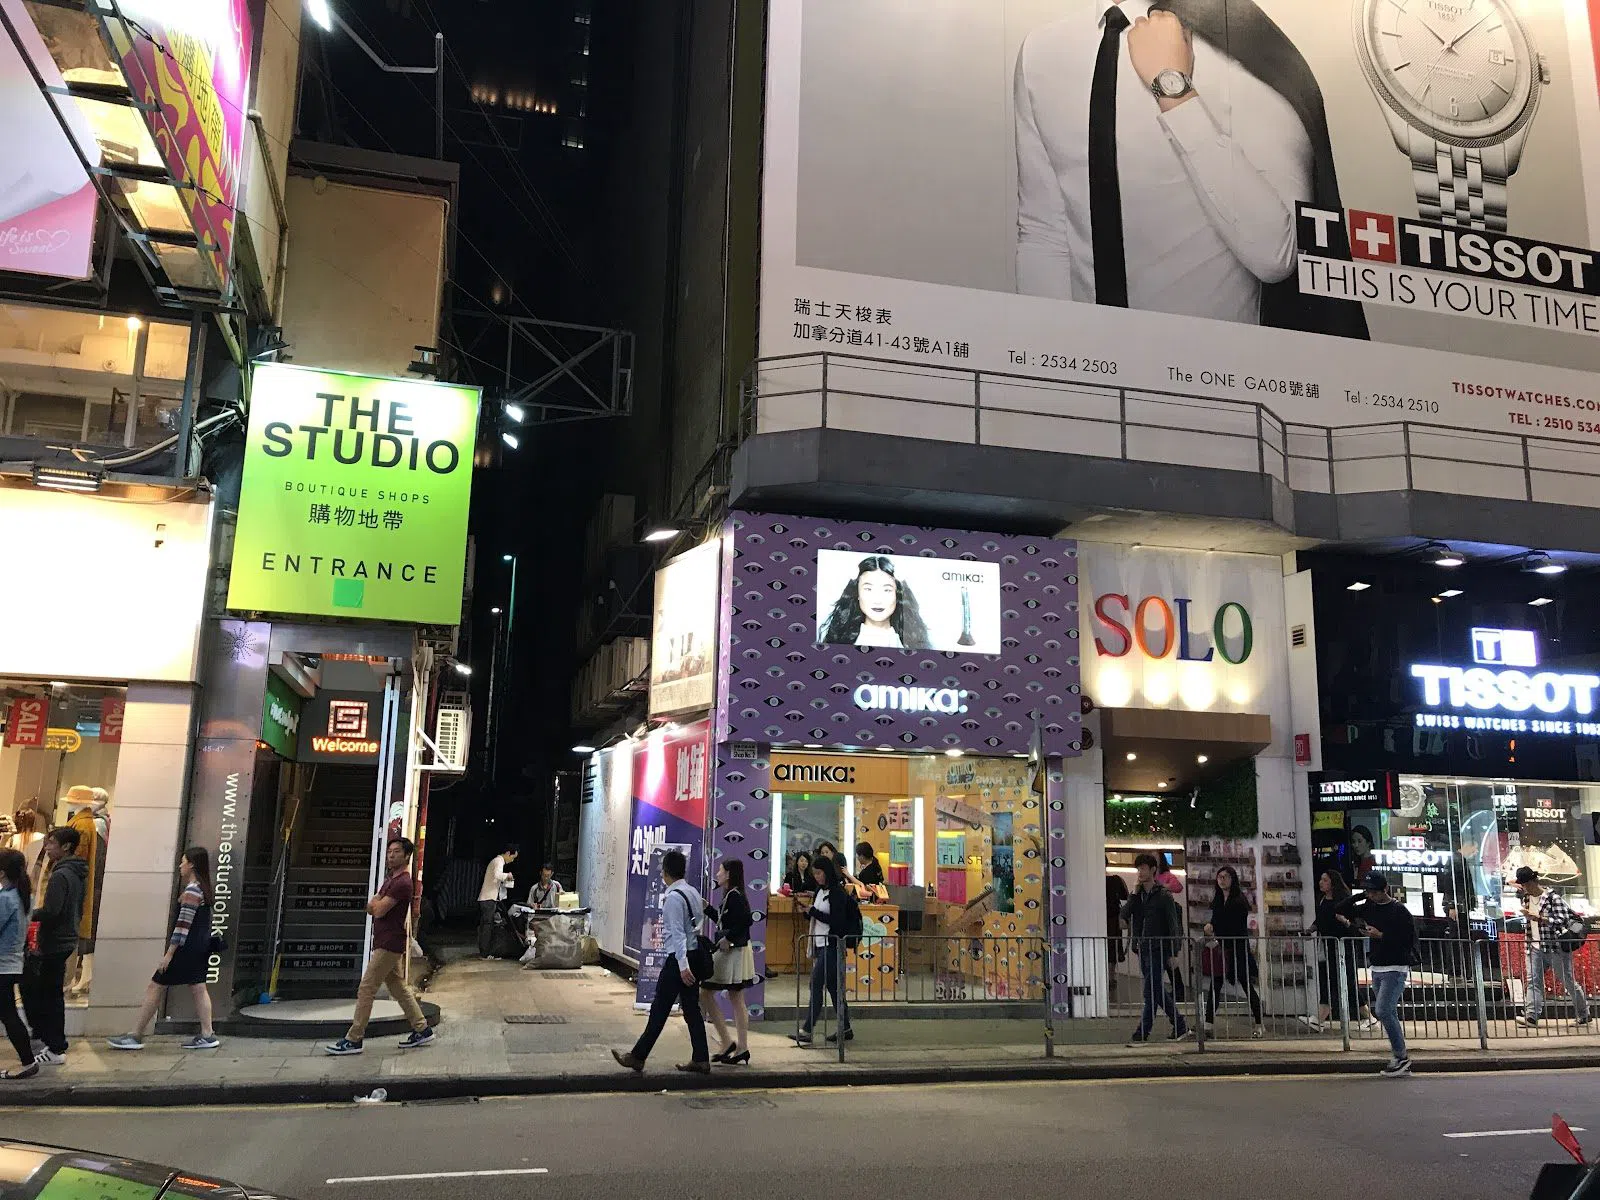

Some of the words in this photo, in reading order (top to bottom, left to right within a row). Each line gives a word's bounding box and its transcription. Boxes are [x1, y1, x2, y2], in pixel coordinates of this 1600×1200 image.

[1404, 224, 1593, 289] TISSOT
[1302, 259, 1379, 299] THIS
[1390, 272, 1416, 304] IS
[1424, 278, 1517, 320] YOUR
[1523, 293, 1600, 333] TIME
[794, 297, 892, 326] 瑞士天梭表
[1007, 350, 1026, 365] Tel
[1040, 353, 1077, 371] 2534
[1082, 358, 1118, 376] 2503
[1167, 366, 1193, 383] The
[1200, 371, 1236, 389] ONE
[316, 392, 415, 436] THE
[1344, 389, 1361, 404] Tel
[1372, 393, 1404, 410] 2534
[1407, 397, 1440, 414] 2510
[1508, 412, 1532, 426] TEL
[1544, 416, 1573, 431] 2510
[262, 421, 459, 475] STUDIO
[285, 481, 369, 498] BOUTIQUE
[378, 490, 430, 504] SHOPS
[308, 503, 404, 531] 購物地帶
[262, 552, 437, 584] ENTRANCE
[1094, 593, 1253, 665] SOLO
[1411, 664, 1600, 714] TISSOT
[16, 701, 41, 743] SALE
[1416, 713, 1460, 728] SWISS
[1464, 716, 1527, 732] WATCHES
[1532, 719, 1571, 734] SINCE
[312, 737, 378, 753] Welcome
[1333, 779, 1376, 794] TISSOT
[1524, 807, 1566, 818] TISSOT
[1262, 831, 1275, 840] No.
[1275, 831, 1296, 840] 41-43
[943, 854, 983, 865] FLASH
[1370, 849, 1453, 866] TISSOT
